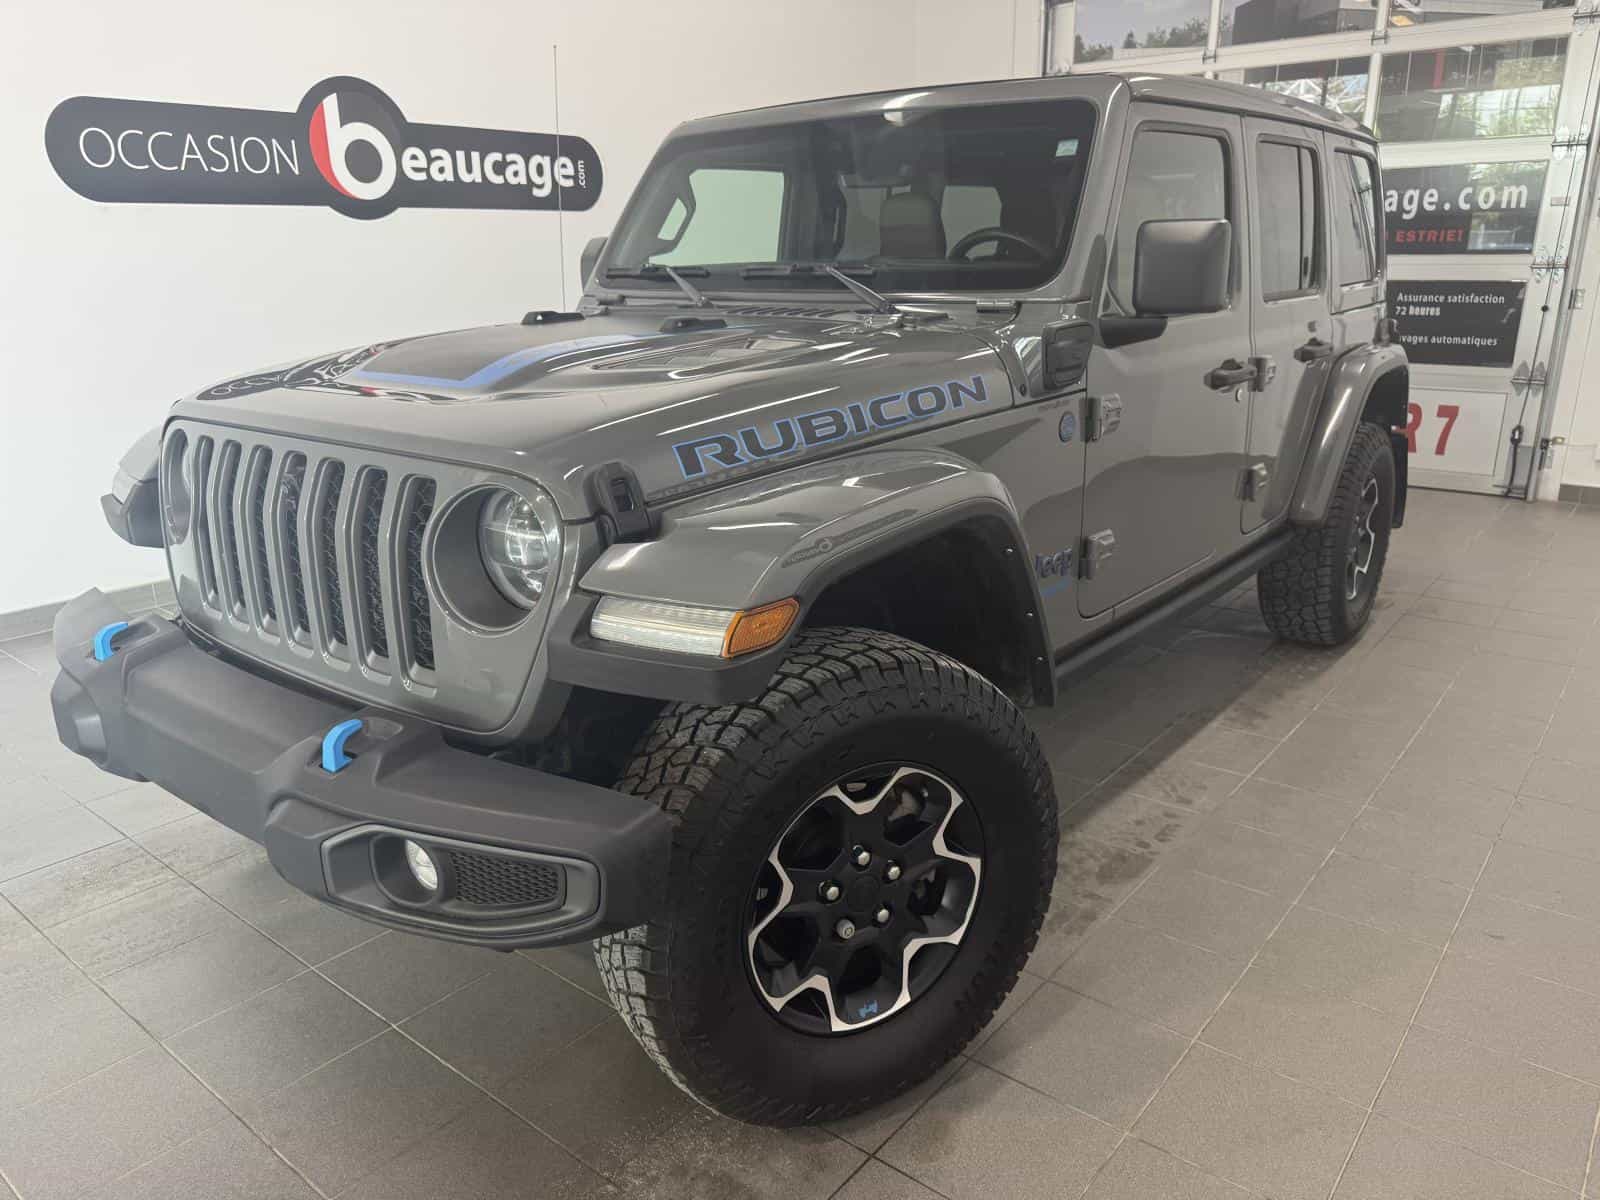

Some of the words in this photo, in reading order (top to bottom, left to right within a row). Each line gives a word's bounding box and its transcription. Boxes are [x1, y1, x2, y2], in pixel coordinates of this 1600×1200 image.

[79, 127, 300, 175] OCCASION
[1395, 306, 1407, 316] 72
[1397, 292, 1445, 303] Assurance
[1447, 292, 1505, 304] satisfaction
[1430, 335, 1498, 347] automatiques
[672, 375, 988, 480] RUBICON
[1434, 404, 1460, 456] 7
